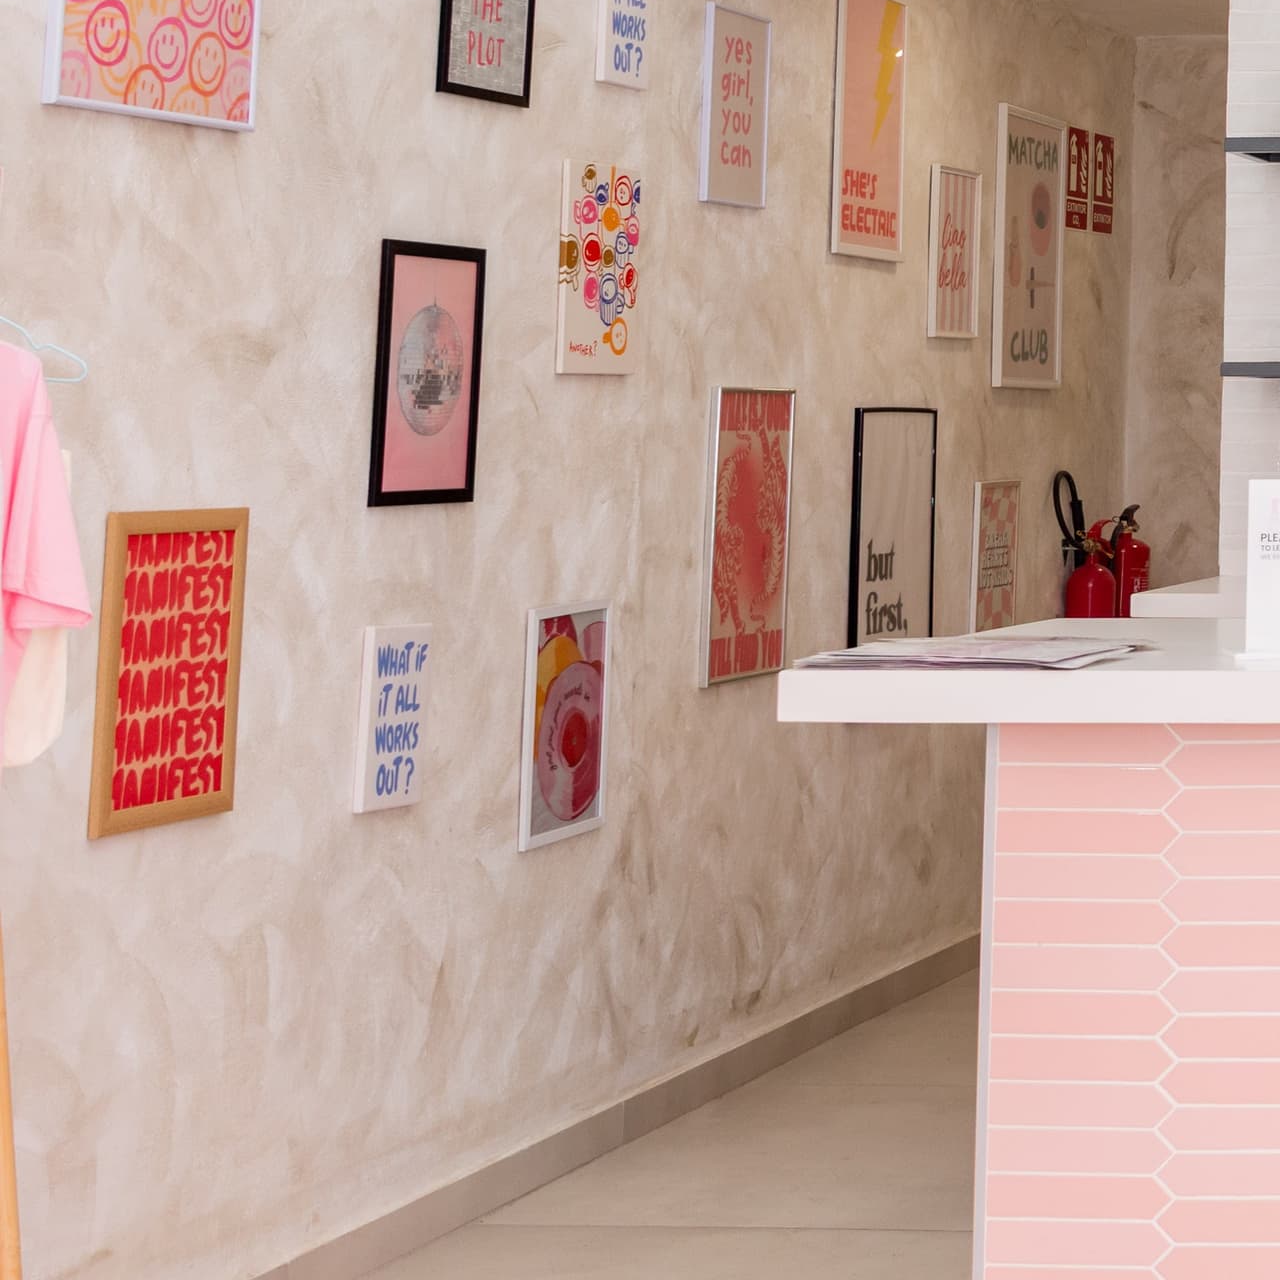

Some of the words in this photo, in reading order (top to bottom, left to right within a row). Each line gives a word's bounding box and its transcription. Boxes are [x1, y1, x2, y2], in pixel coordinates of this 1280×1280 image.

[612, 10, 646, 41] WORKS
[467, 30, 505, 67] PLOT
[725, 35, 753, 65] yes
[721, 69, 754, 107] girl,
[721, 107, 752, 136] you
[720, 140, 752, 169] can
[1008, 133, 1059, 173] MATCHA
[842, 170, 878, 200] SHE'S
[841, 204, 897, 239] ELECTRIC
[942, 213, 967, 250] Ciao
[938, 252, 967, 291] bella
[1010, 328, 1049, 366] CLUB
[866, 537, 895, 583] but
[865, 591, 908, 635] first,
[378, 641, 415, 678] WHAT
[395, 684, 420, 715] ALL
[375, 722, 420, 755] WORKS
